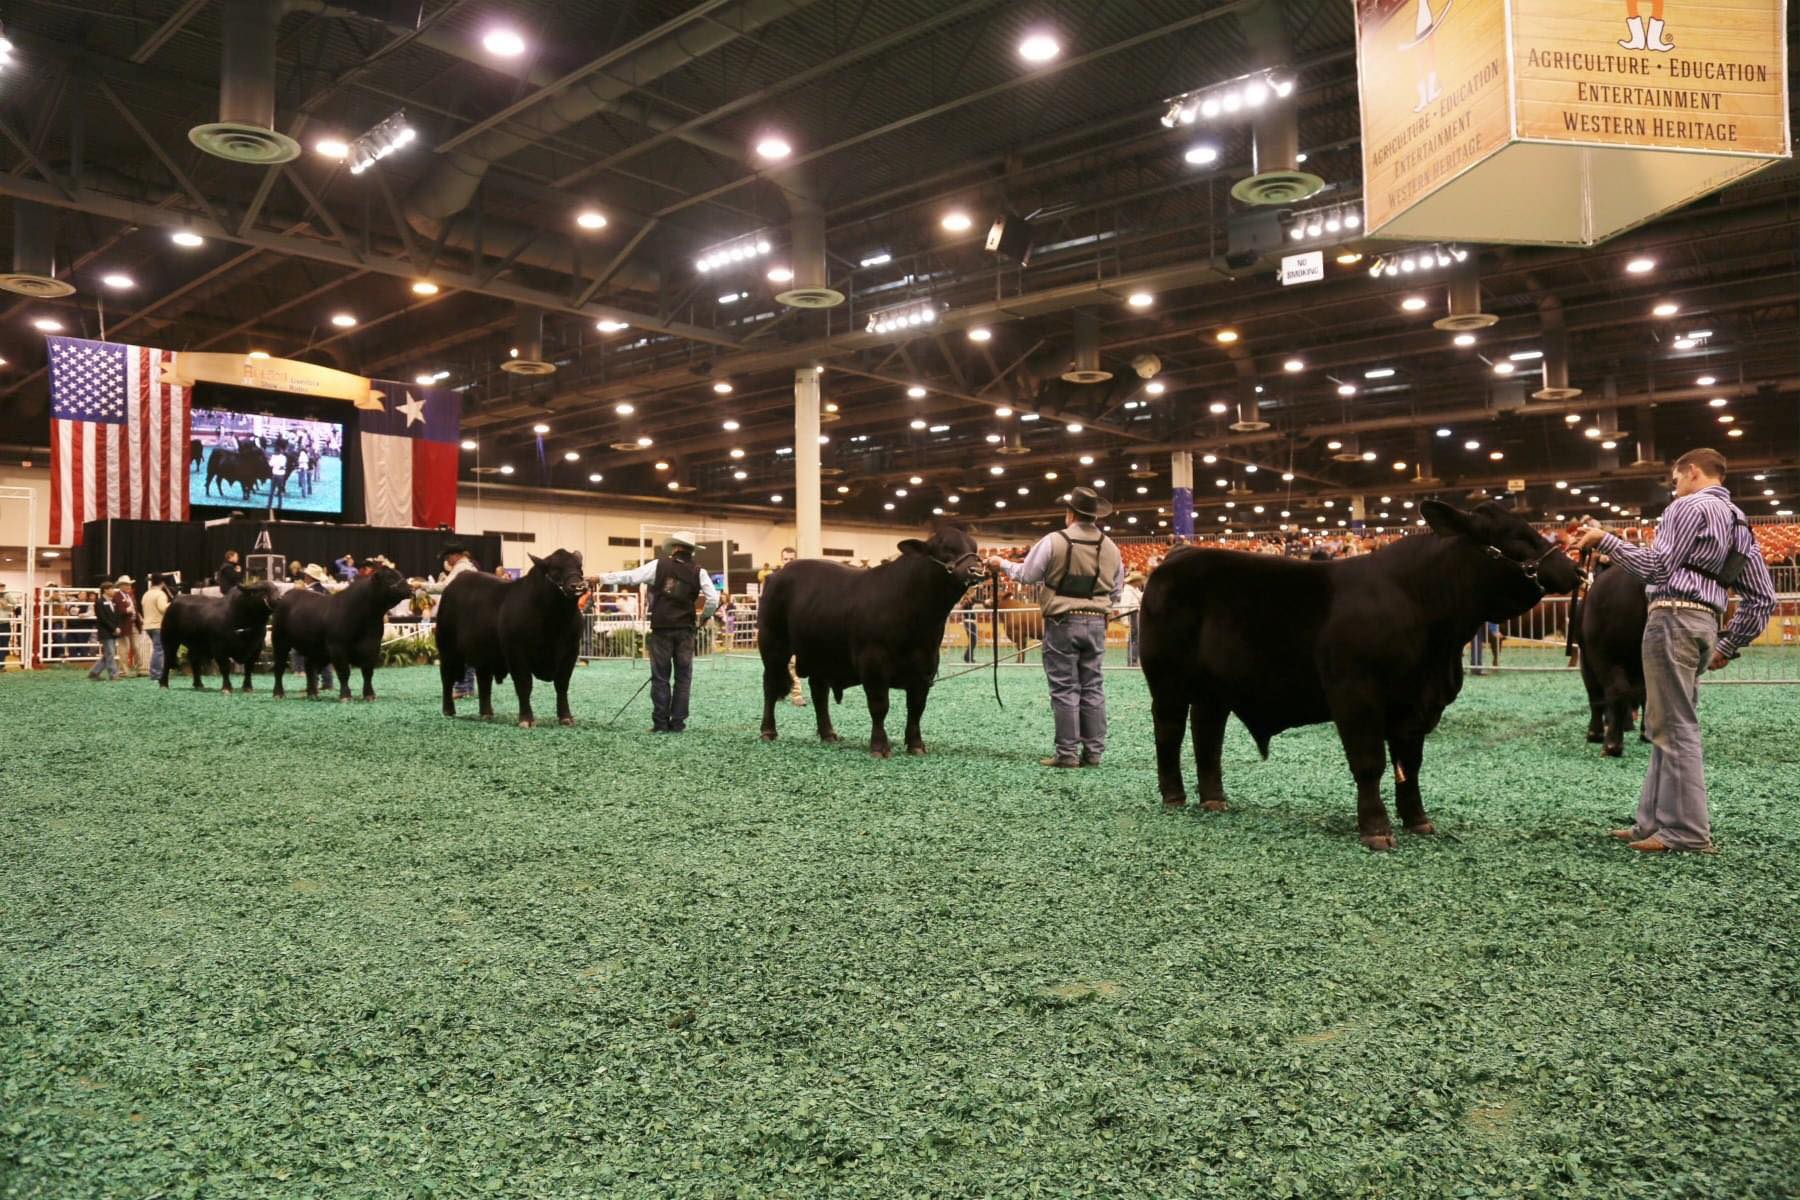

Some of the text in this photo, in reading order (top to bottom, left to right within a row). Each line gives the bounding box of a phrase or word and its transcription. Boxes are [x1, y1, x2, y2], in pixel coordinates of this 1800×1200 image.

[1528, 48, 1767, 82] AGRICULTURE EDUCATION
[1578, 81, 1722, 110] ENTERTAINMENT
[1373, 58, 1500, 168] AGRICULTURE EDUCATION
[1563, 111, 1737, 142] WESTERN HERITAGE
[1393, 111, 1472, 179] ENTERTAINMENT
[1387, 133, 1482, 209] WESTERN HERITAGE
[1287, 267, 1319, 279] SMOKING
[1297, 259, 1307, 267] NO
